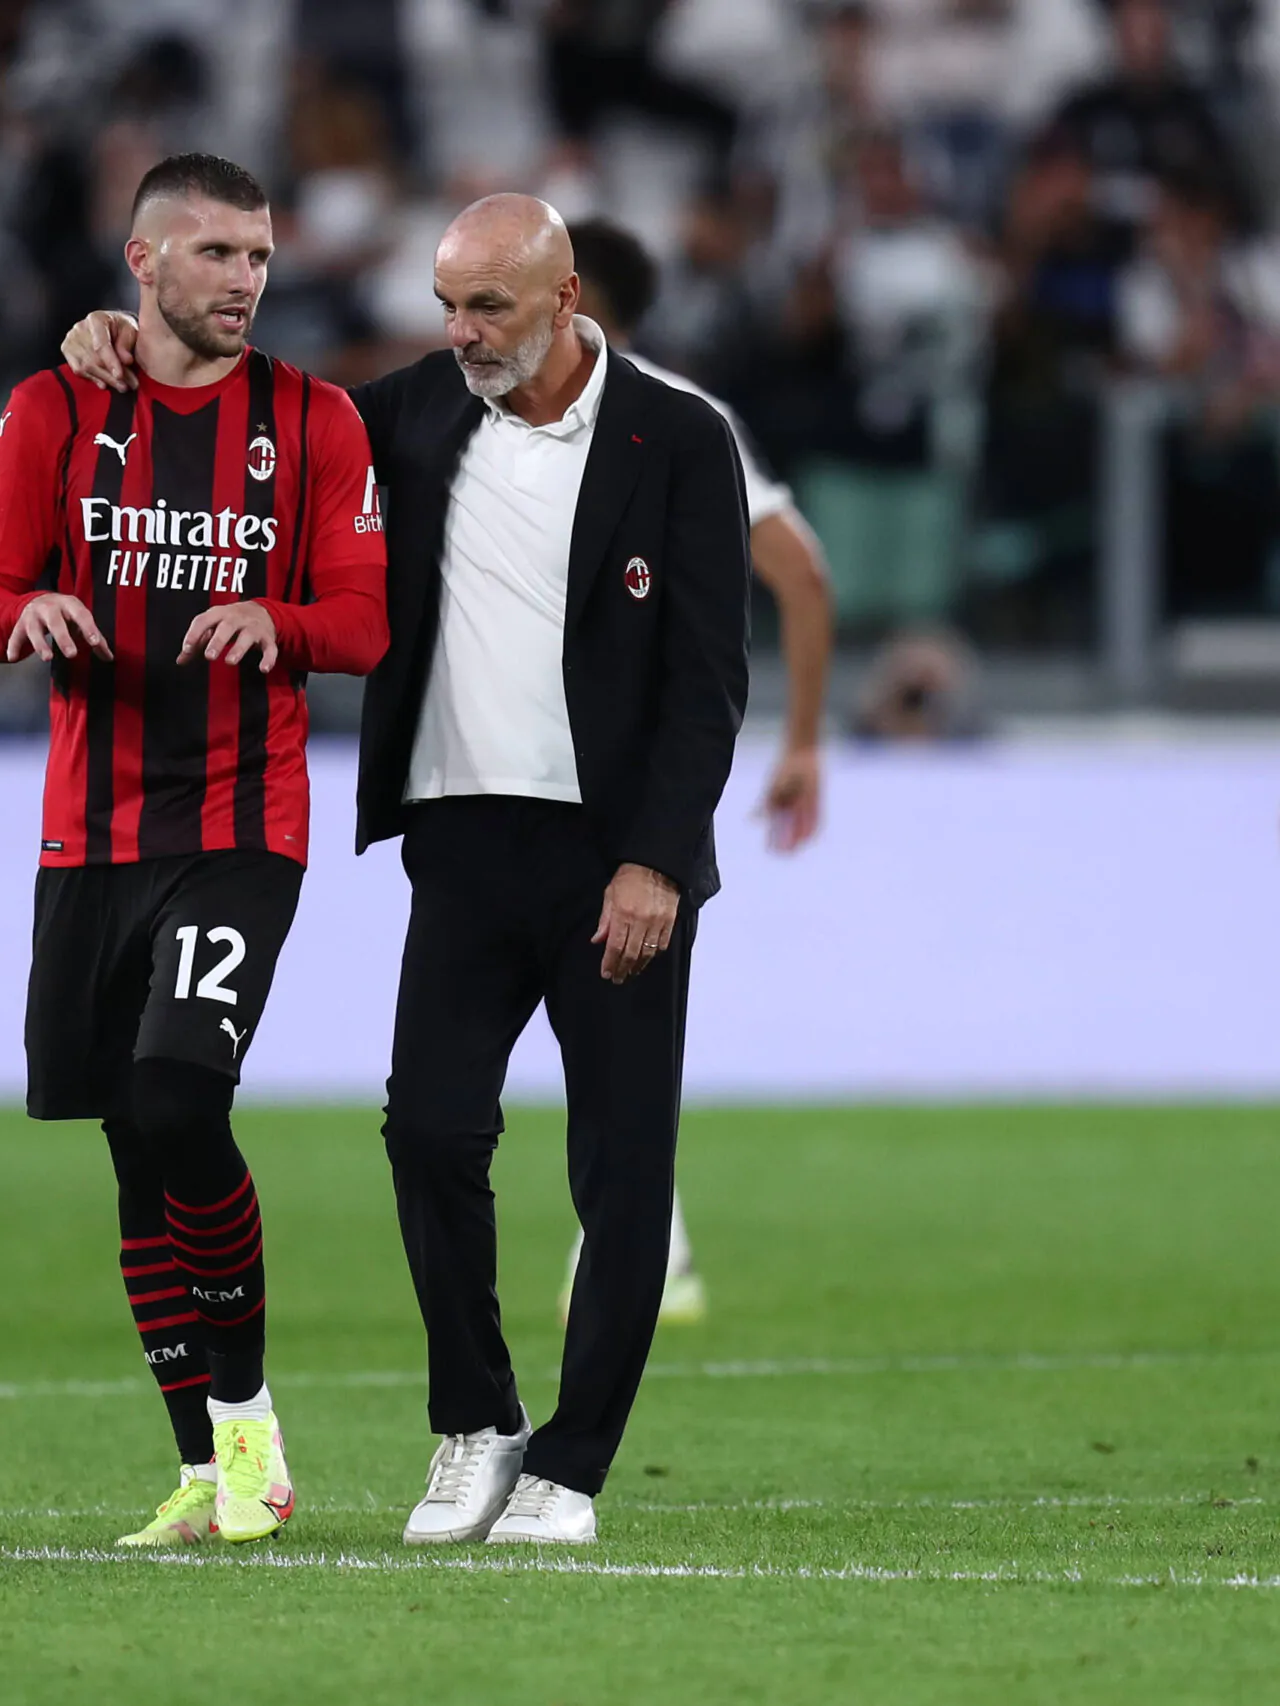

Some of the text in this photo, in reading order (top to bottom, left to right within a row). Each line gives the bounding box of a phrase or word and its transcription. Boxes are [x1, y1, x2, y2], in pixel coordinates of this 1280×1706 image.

[80, 497, 278, 553] Emirates
[107, 549, 248, 594] FLY BETTER
[174, 925, 246, 1006] 12
[192, 1285, 245, 1302] ACM
